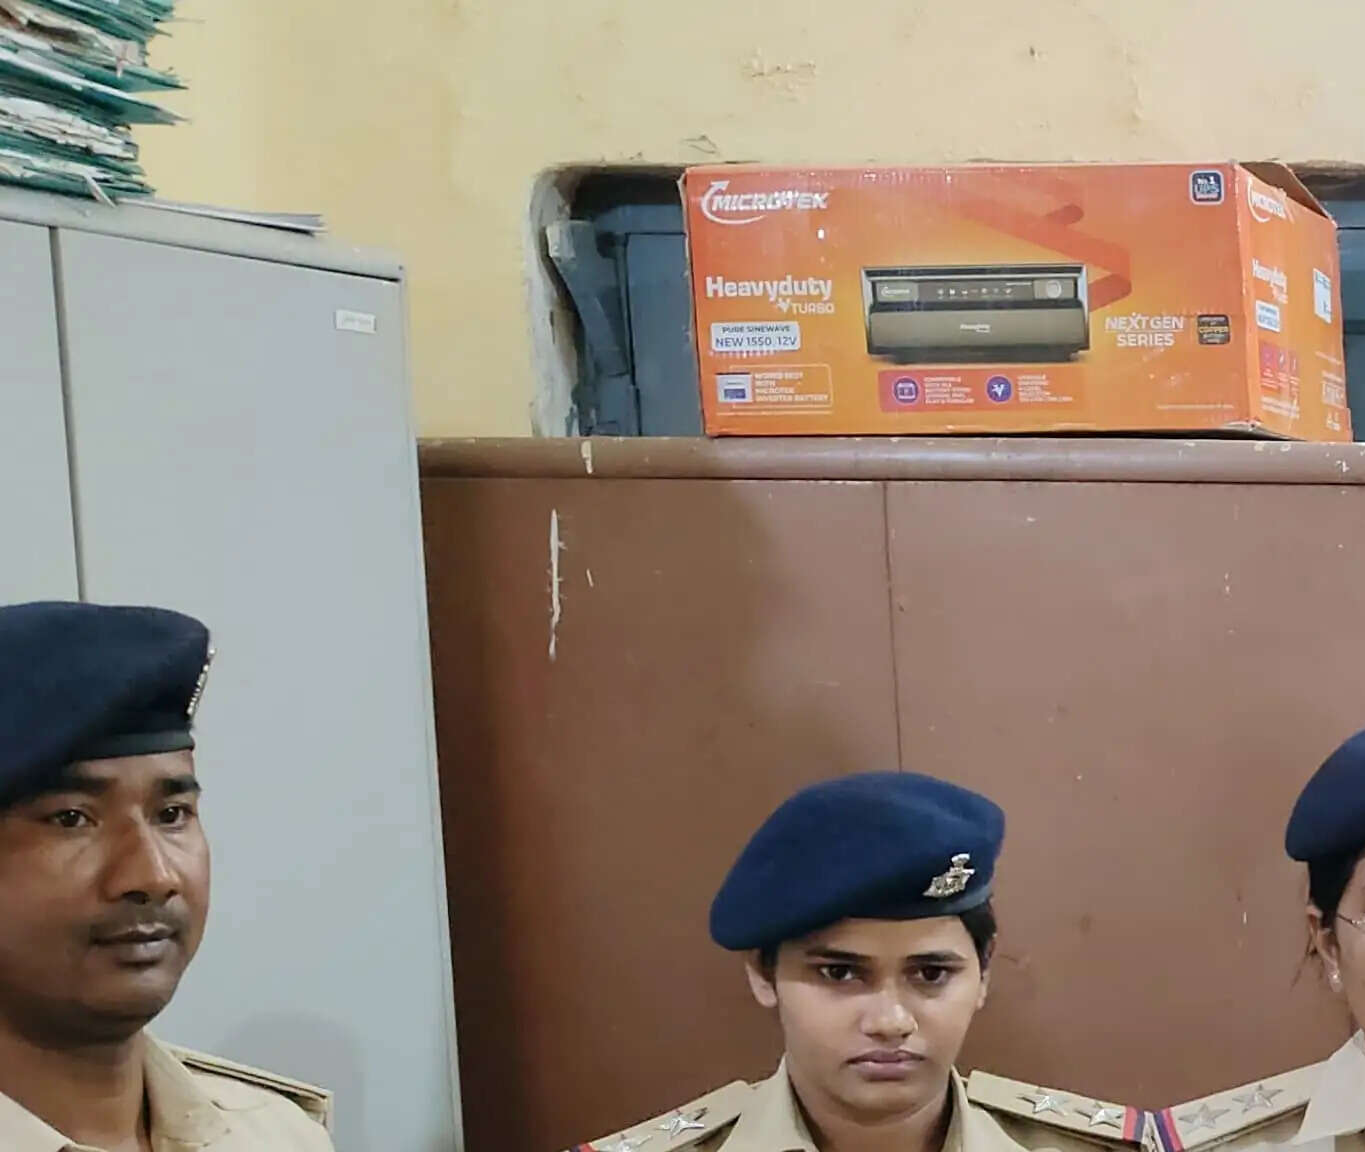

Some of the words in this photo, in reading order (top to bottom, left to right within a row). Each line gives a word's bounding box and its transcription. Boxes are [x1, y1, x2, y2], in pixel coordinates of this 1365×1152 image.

[712, 190, 831, 211] MICROTEK
[706, 275, 832, 302] Heavyduty
[791, 302, 835, 314] TURBO
[746, 325, 791, 333] SINEWAVE
[1150, 316, 1184, 330] GEN
[715, 338, 743, 347] NEW
[746, 337, 772, 346] 1550
[778, 336, 797, 346] 12V
[1116, 332, 1175, 347] SERIES
